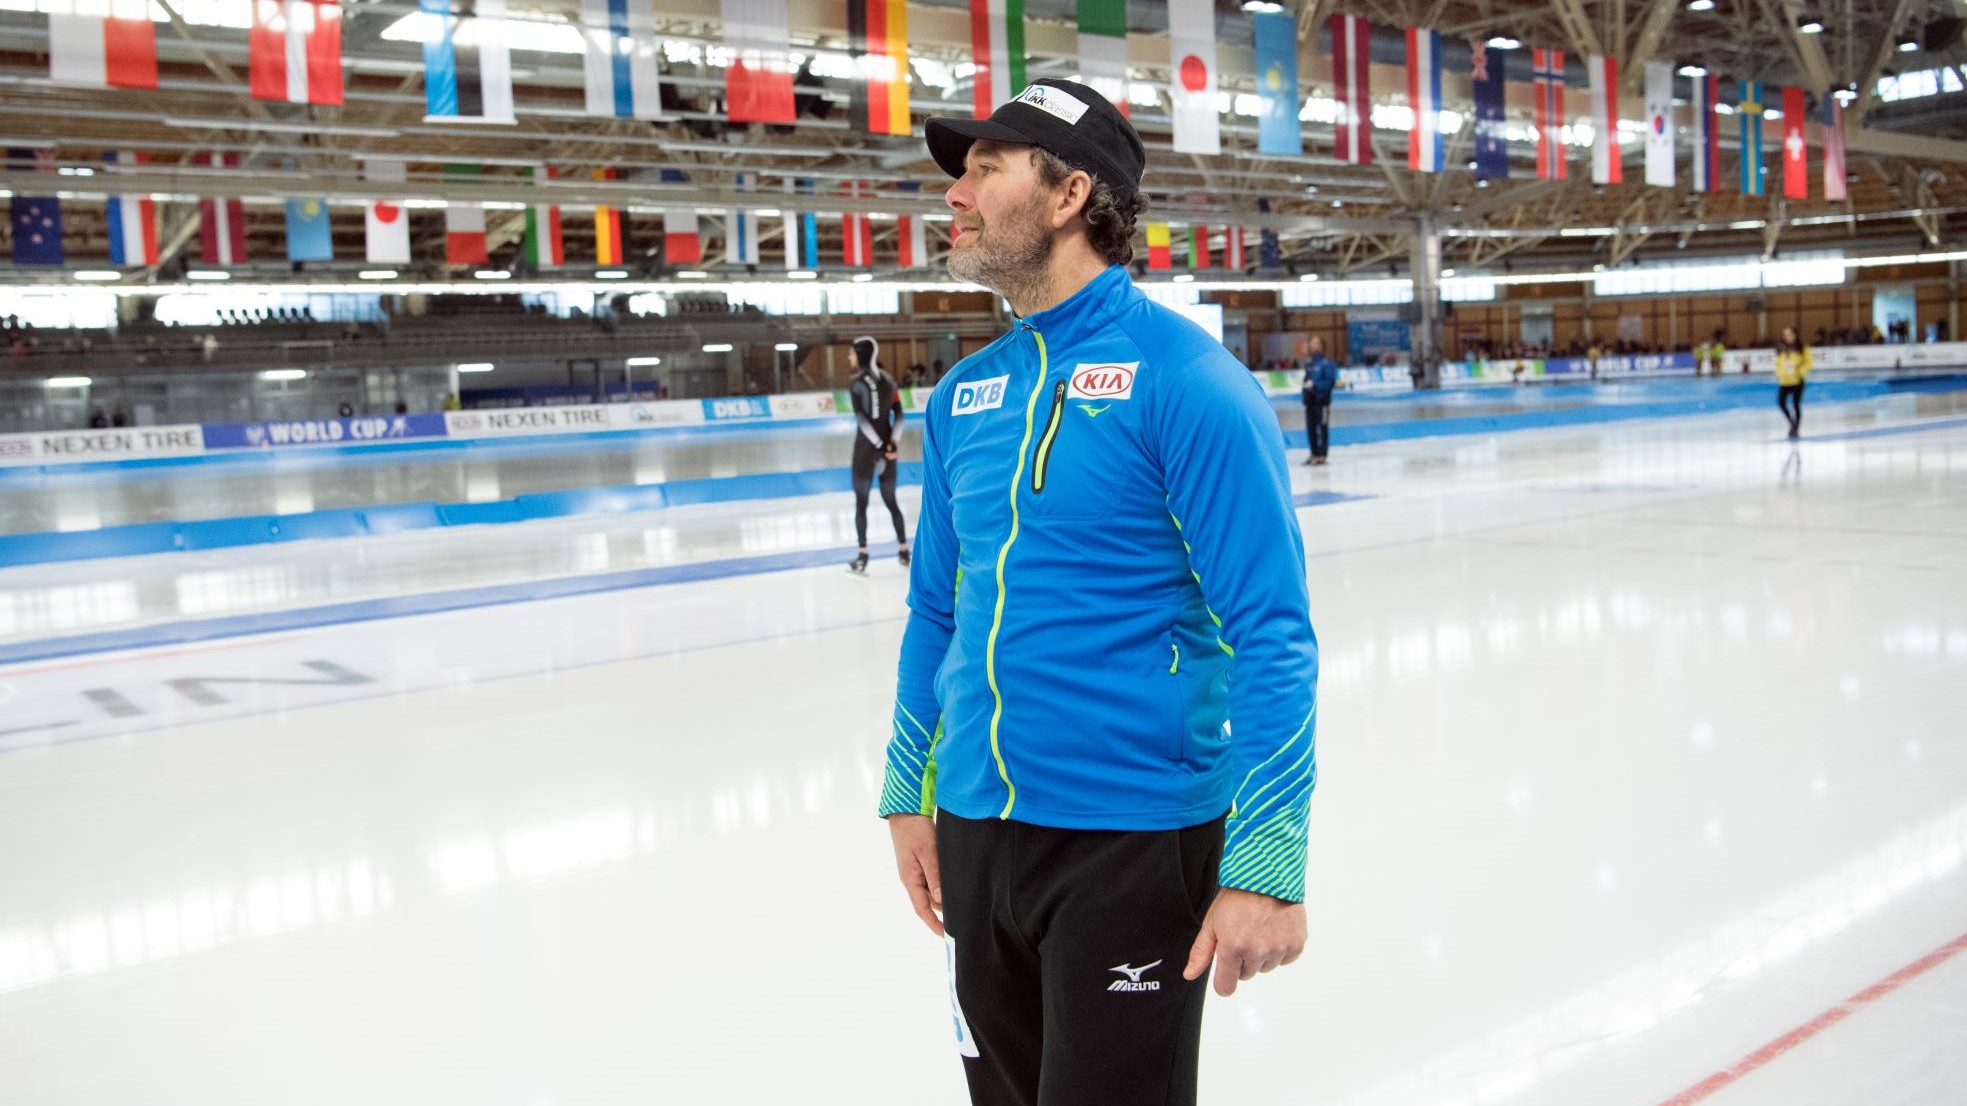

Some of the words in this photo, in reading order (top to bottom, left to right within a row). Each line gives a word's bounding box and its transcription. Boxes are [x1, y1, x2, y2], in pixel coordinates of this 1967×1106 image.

[1083, 373, 1122, 390] KIA
[957, 382, 1002, 410] DKB
[488, 410, 556, 429] NEXEN
[560, 409, 608, 424] TIRE
[268, 420, 343, 444] WORLD
[351, 418, 389, 438] CUP
[43, 433, 131, 455] NEXEN
[142, 430, 200, 449] TIRE
[1107, 980, 1160, 991] MIZUNO
